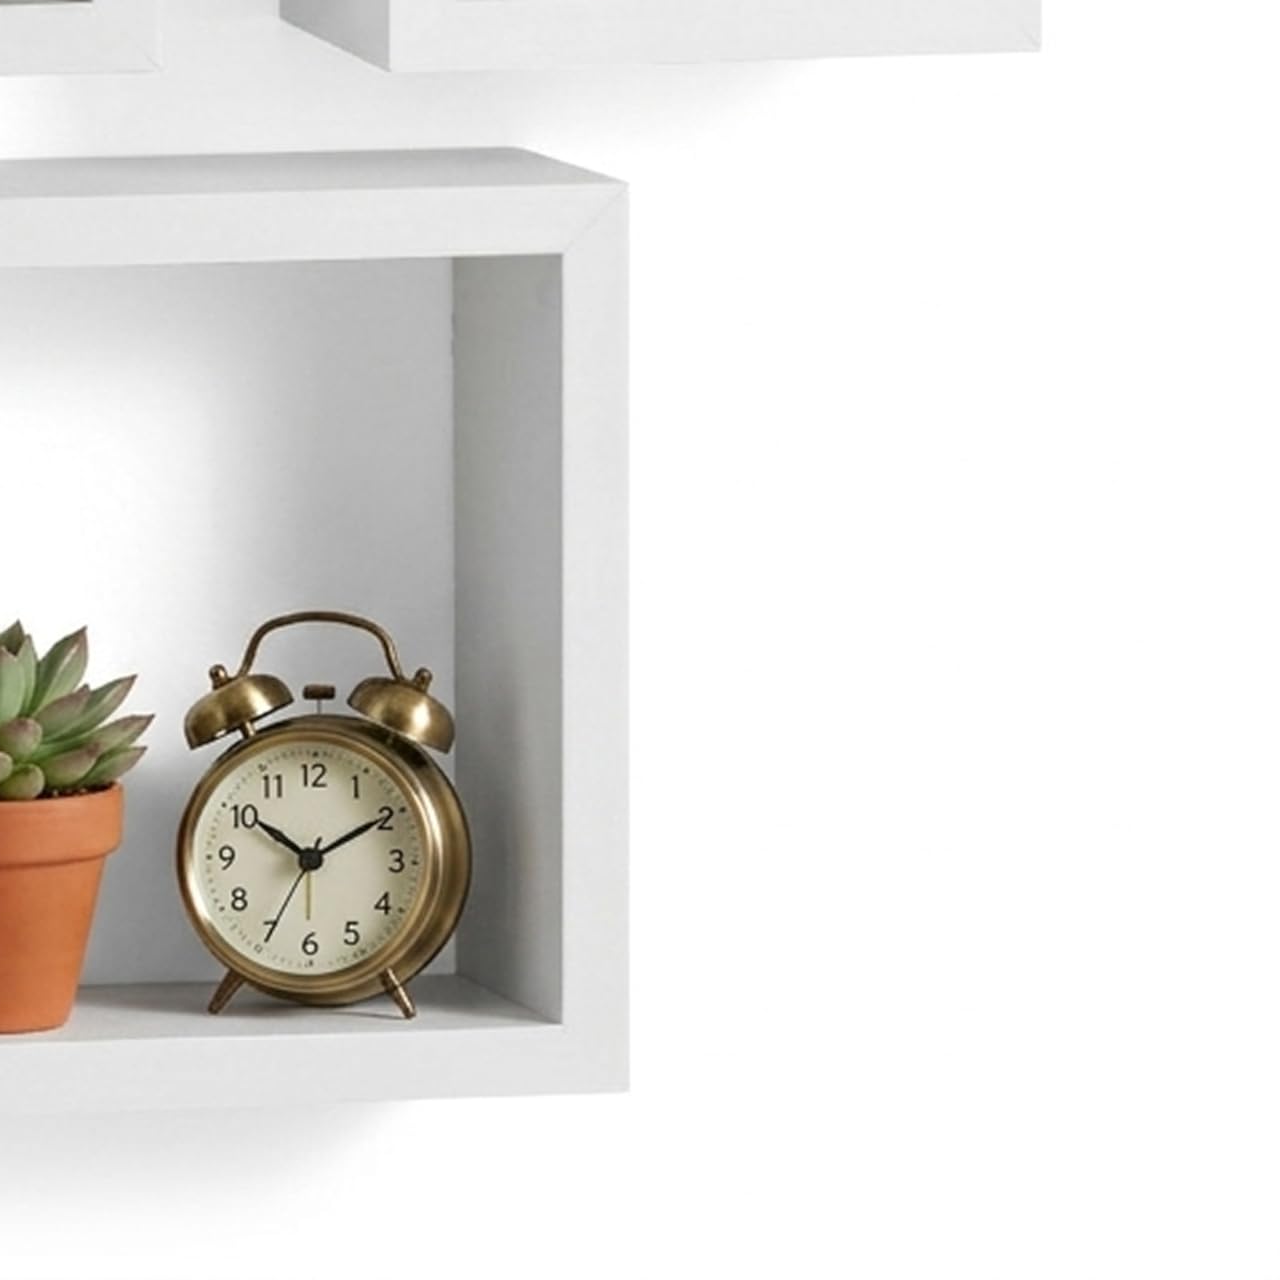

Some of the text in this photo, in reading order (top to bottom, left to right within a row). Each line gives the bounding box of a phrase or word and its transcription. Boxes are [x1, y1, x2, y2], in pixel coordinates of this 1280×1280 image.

[263, 775, 283, 798] 11
[301, 764, 327, 787] 12
[351, 776, 360, 799] 1
[231, 804, 258, 828] 10
[376, 806, 394, 830] 2
[219, 845, 235, 870] 9
[389, 850, 405, 873] 3
[231, 887, 248, 911] 8
[374, 892, 391, 915] 4
[263, 922, 278, 943] 7
[302, 932, 318, 955] 6
[344, 922, 360, 945] 5
